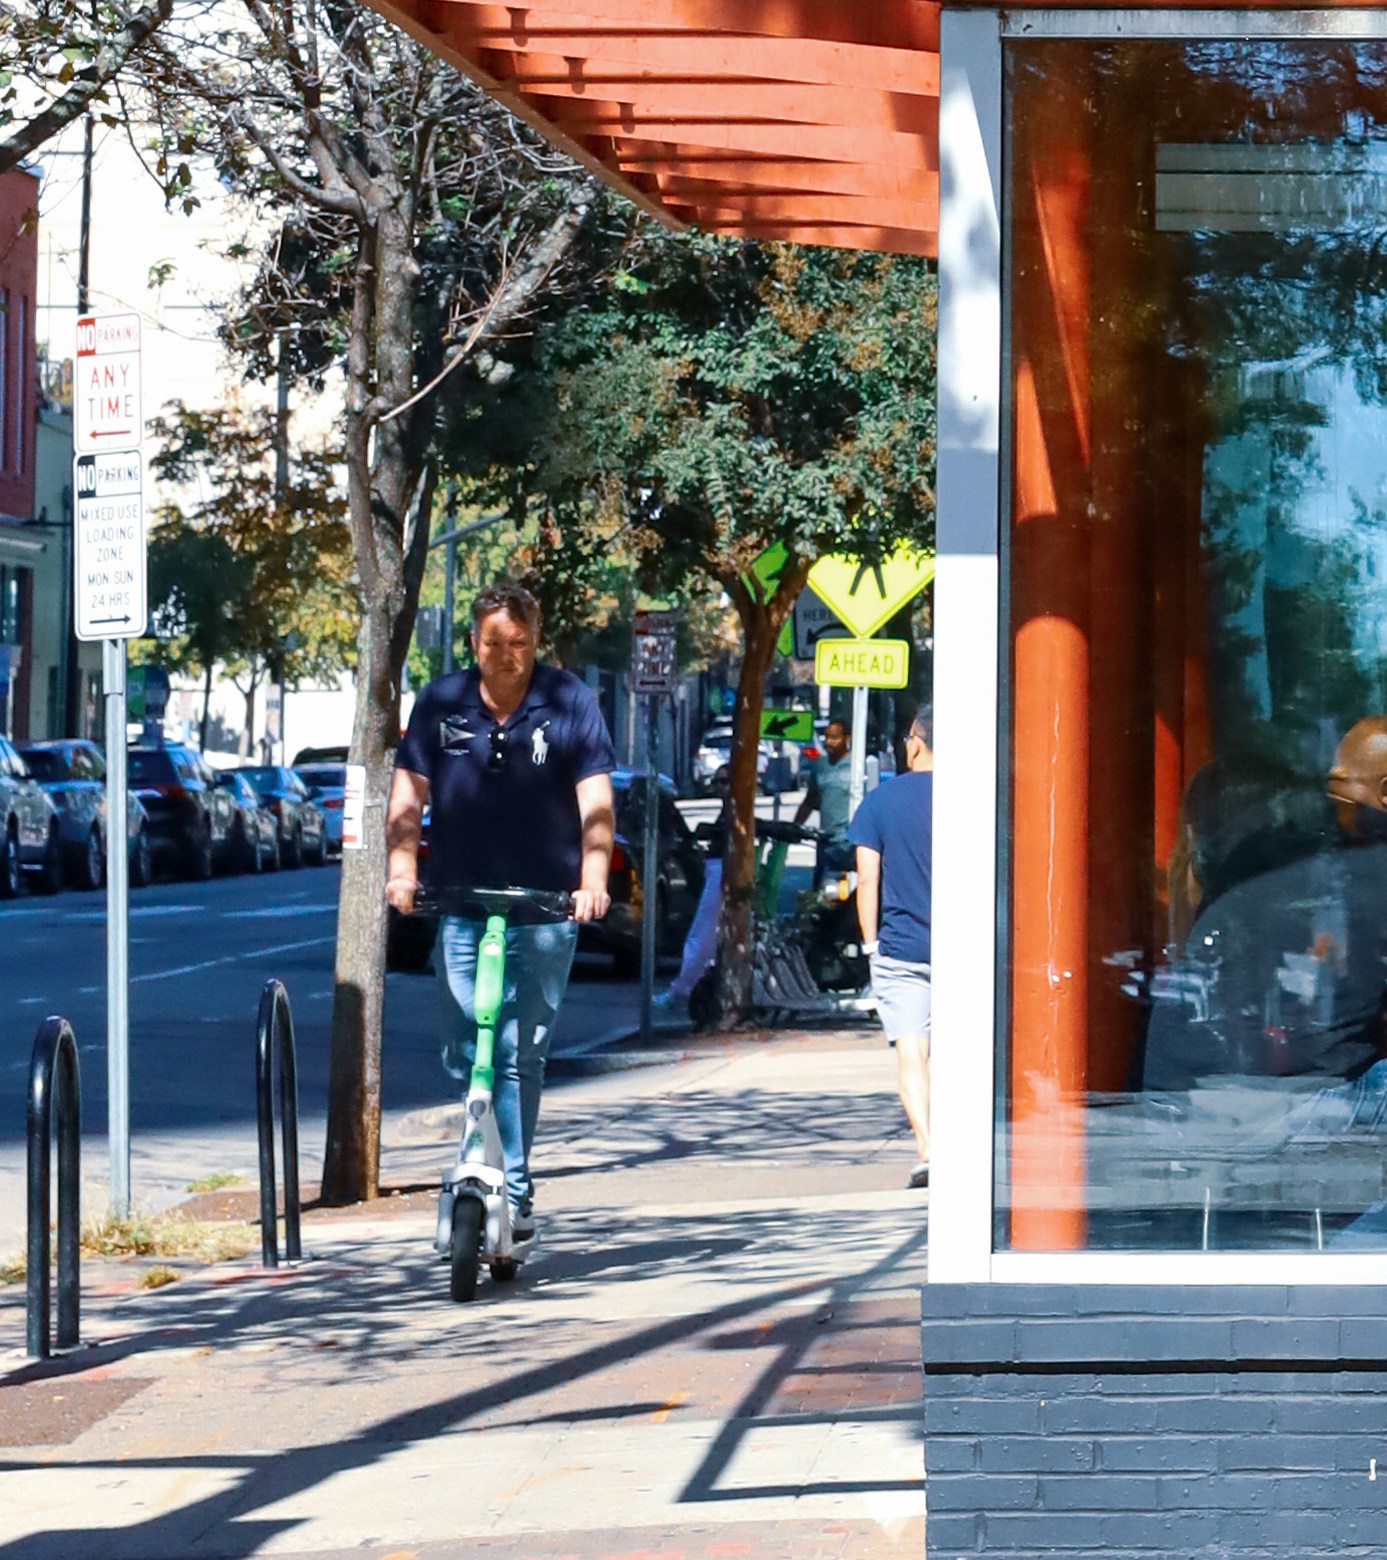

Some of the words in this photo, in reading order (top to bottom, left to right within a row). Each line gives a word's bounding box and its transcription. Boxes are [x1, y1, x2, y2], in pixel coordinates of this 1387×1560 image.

[77, 324, 96, 351] NO
[98, 326, 138, 344] PARKING
[90, 363, 130, 390] ANY
[88, 394, 134, 421] TIME
[78, 465, 96, 491] NO
[98, 465, 139, 484] PARKING
[81, 505, 115, 521] MIXED
[118, 504, 139, 520] USE
[86, 526, 134, 544] LOADING
[97, 546, 125, 562] ZONE
[87, 572, 109, 587] MON
[114, 570, 134, 585] SUN
[91, 594, 105, 609] 24
[109, 591, 131, 607] HRS
[829, 652, 895, 674] AHEAD
